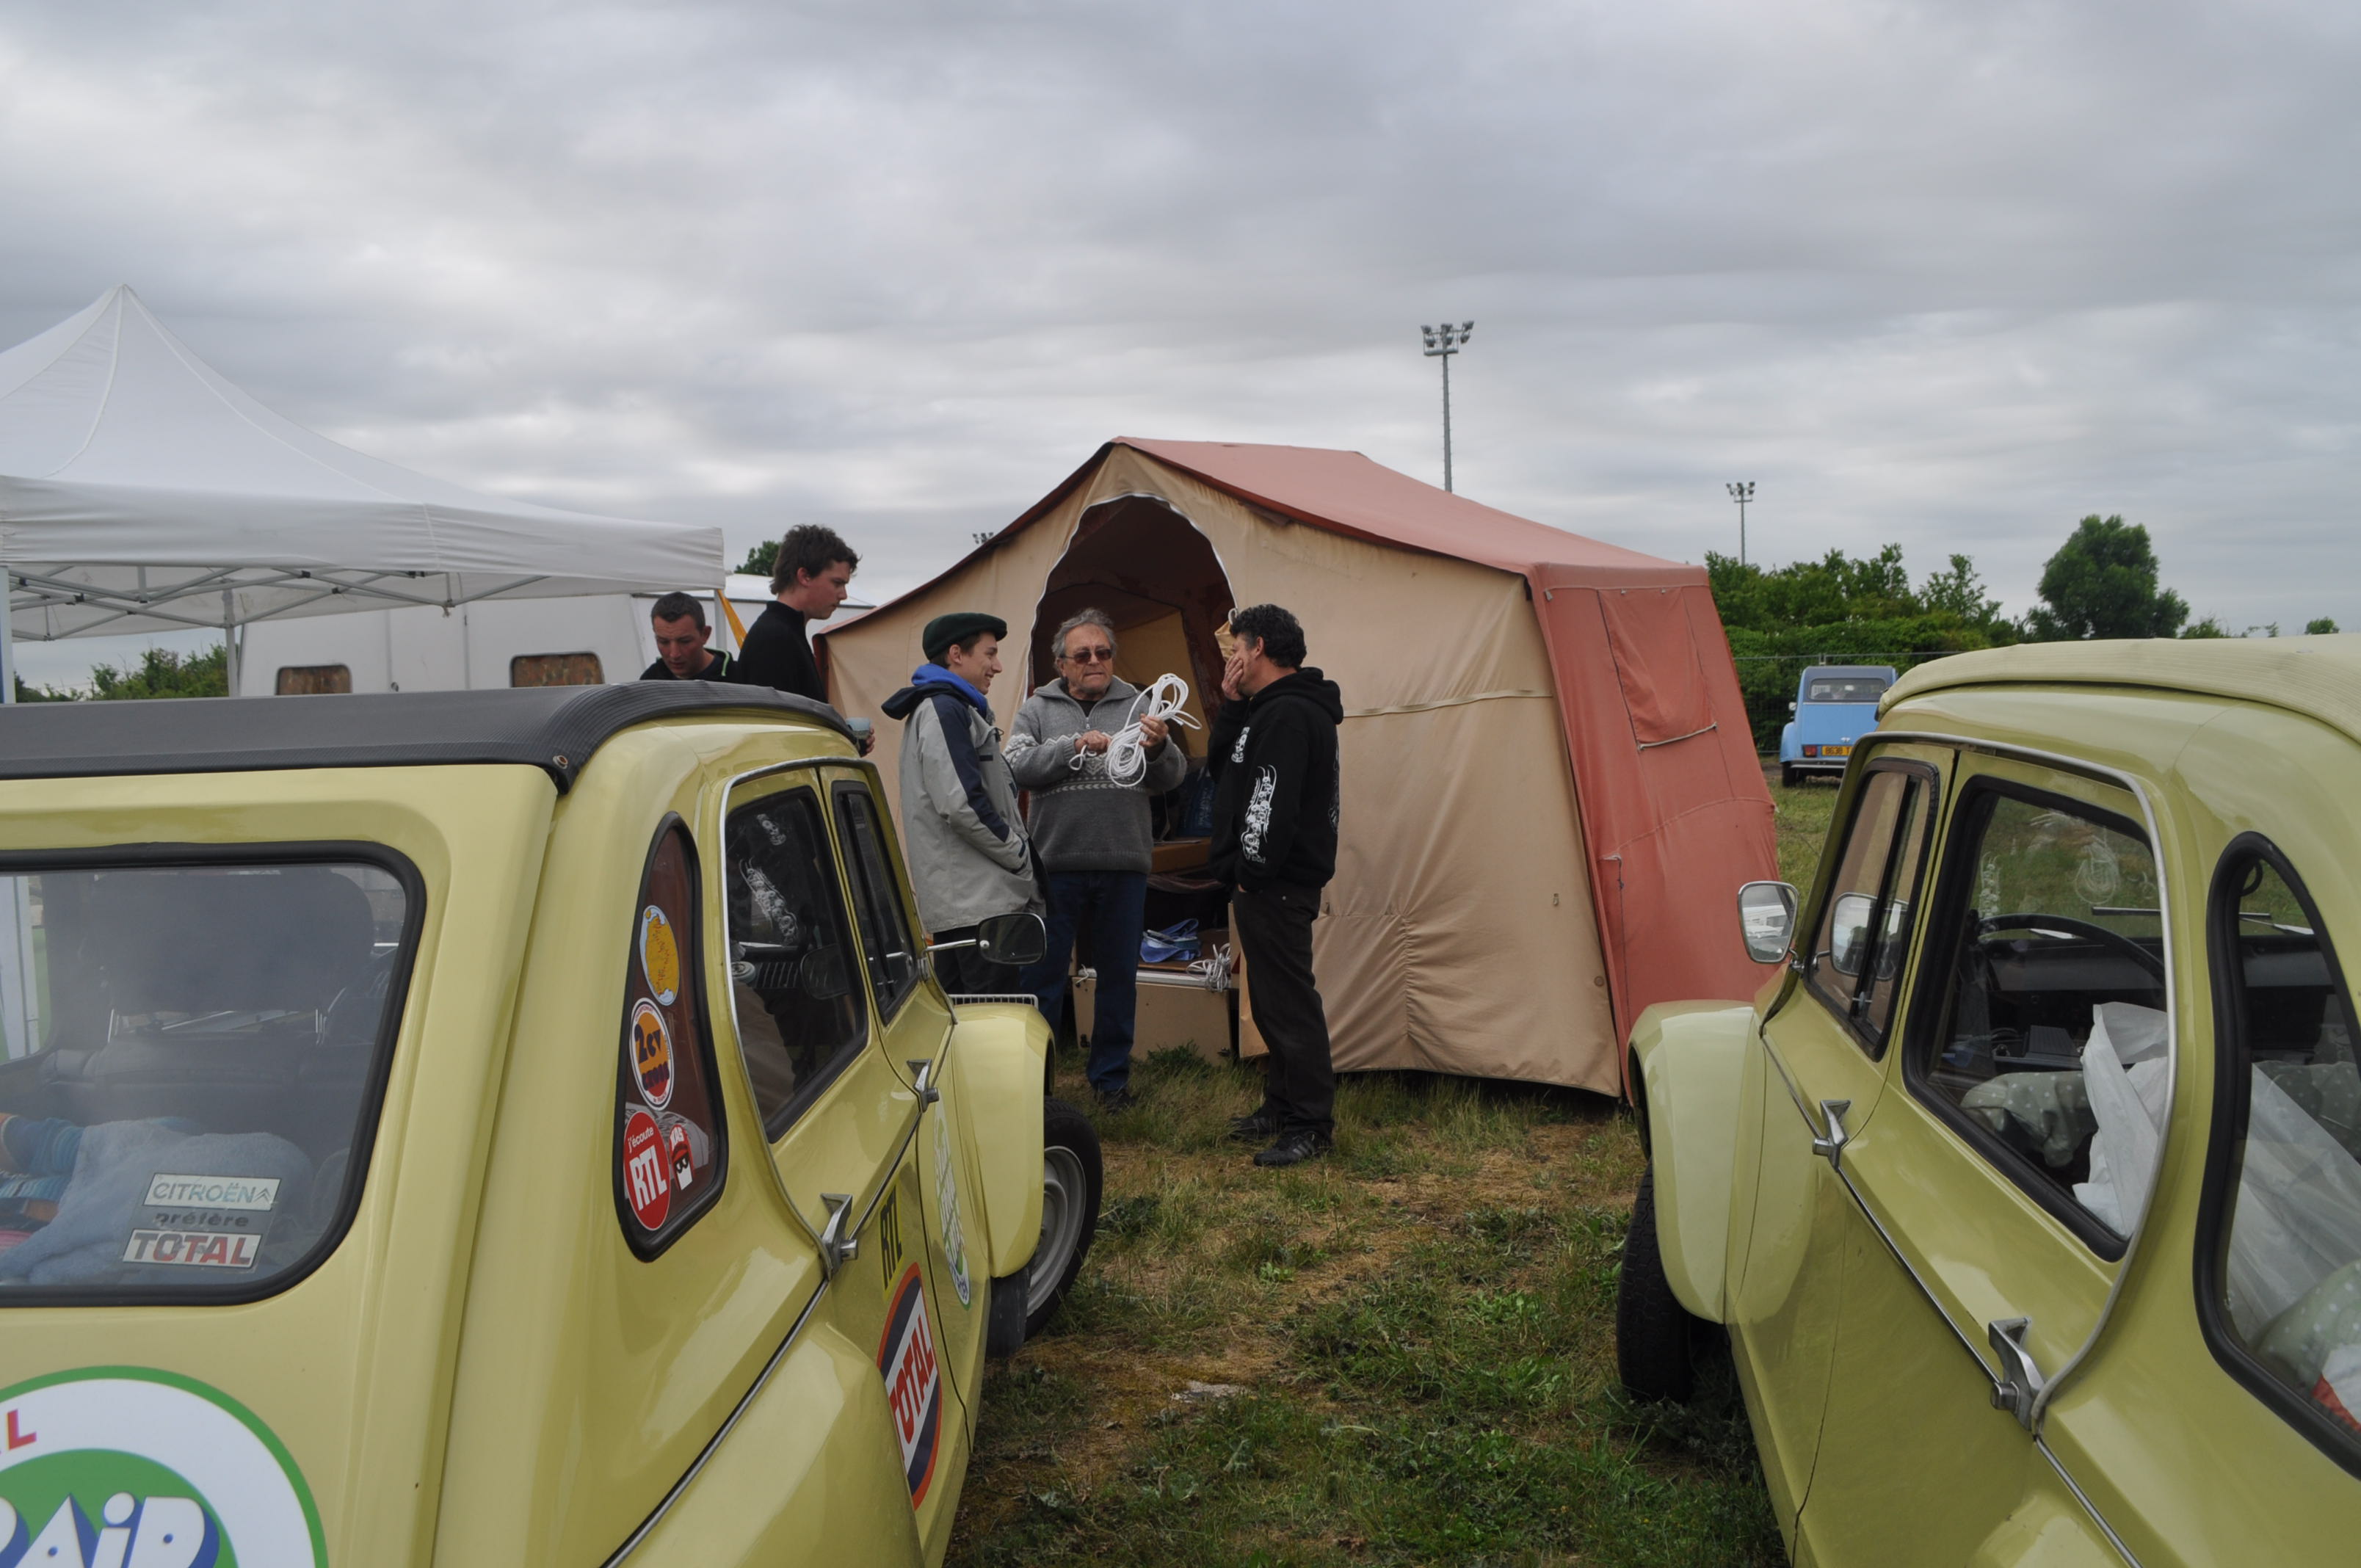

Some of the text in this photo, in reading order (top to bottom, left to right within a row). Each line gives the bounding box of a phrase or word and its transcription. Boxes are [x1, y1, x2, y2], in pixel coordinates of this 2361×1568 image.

[628, 1127, 654, 1153] j'écoute
[153, 1183, 256, 1203] CITROËN
[629, 1145, 667, 1211] RTL
[154, 1212, 250, 1227] préfère
[133, 1232, 251, 1266] TOTAL
[880, 1184, 902, 1291] RTL
